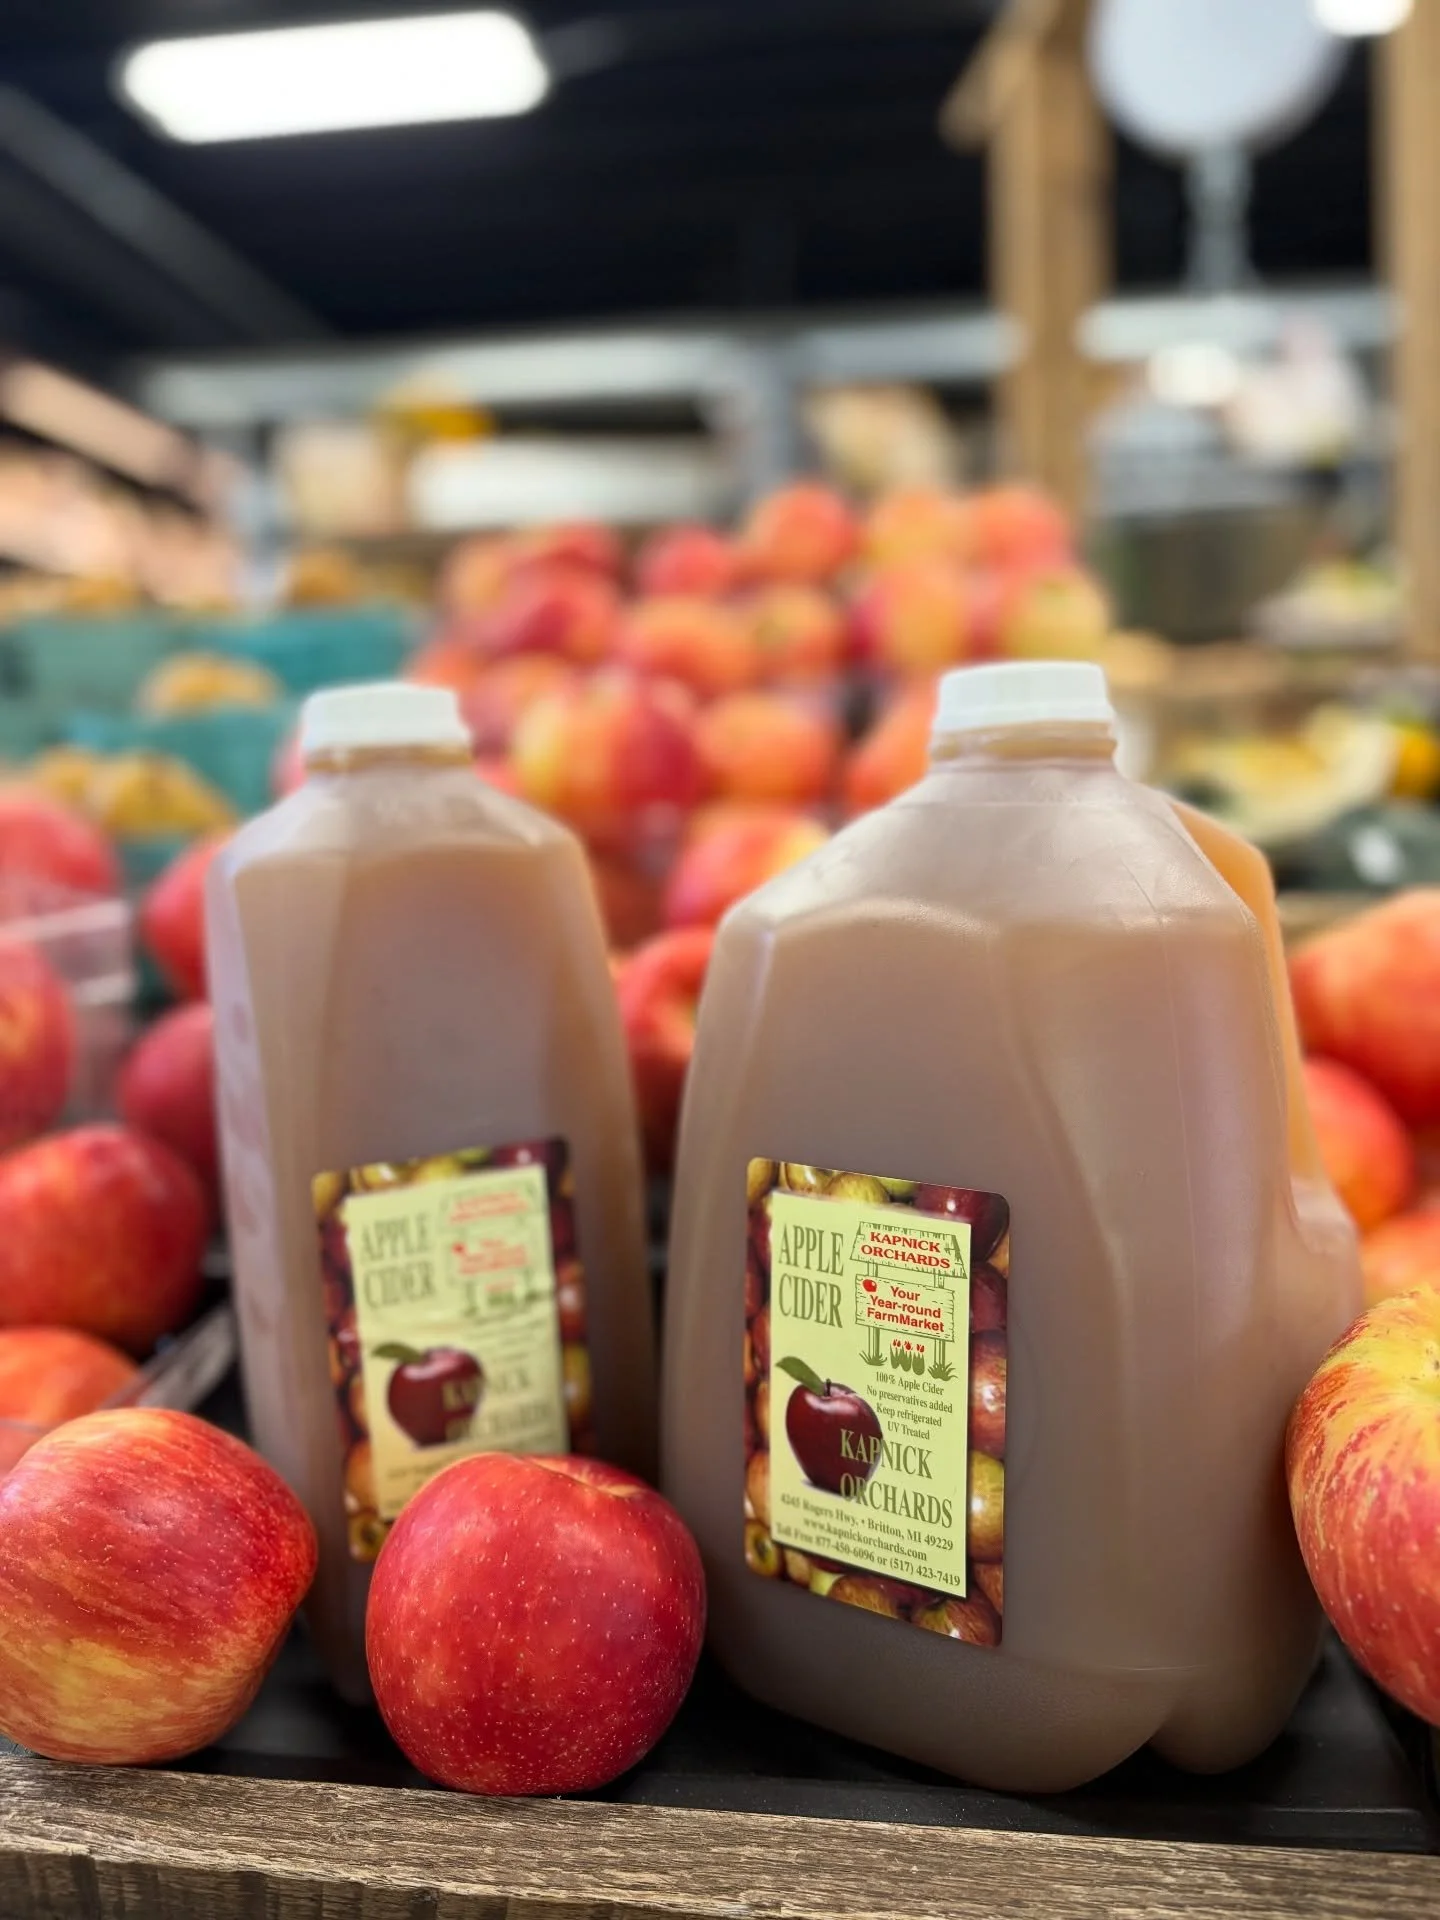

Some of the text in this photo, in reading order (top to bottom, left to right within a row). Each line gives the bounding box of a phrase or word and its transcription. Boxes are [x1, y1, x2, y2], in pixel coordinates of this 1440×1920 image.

[778, 1222, 844, 1277] APPLE
[870, 1231, 941, 1253] KAPNICK
[861, 1244, 950, 1269] ORCHARDS
[779, 1273, 843, 1329] CIDER
[890, 1286, 920, 1301] Your
[867, 1307, 945, 1332] FarmMarket
[870, 1295, 941, 1319] Year-round
[875, 1371, 944, 1396] 100% Apple Cider
[866, 1385, 953, 1413] No preservatives added
[876, 1402, 942, 1427] Keep refrigerated
[887, 1420, 930, 1440] UV Treated
[840, 1428, 933, 1480] KAPNICK
[840, 1472, 953, 1529] ORCHARDS
[803, 1499, 834, 1518] Rogers
[835, 1508, 859, 1526] Hwy.
[868, 1518, 905, 1540] Britton,
[907, 1529, 922, 1543] MI
[924, 1533, 953, 1551] 49229
[803, 1517, 928, 1561] www.kapnickorchards.com
[877, 1556, 887, 1566] or
[889, 1558, 914, 1575] (517)
[916, 1566, 960, 1587] 423-7419
